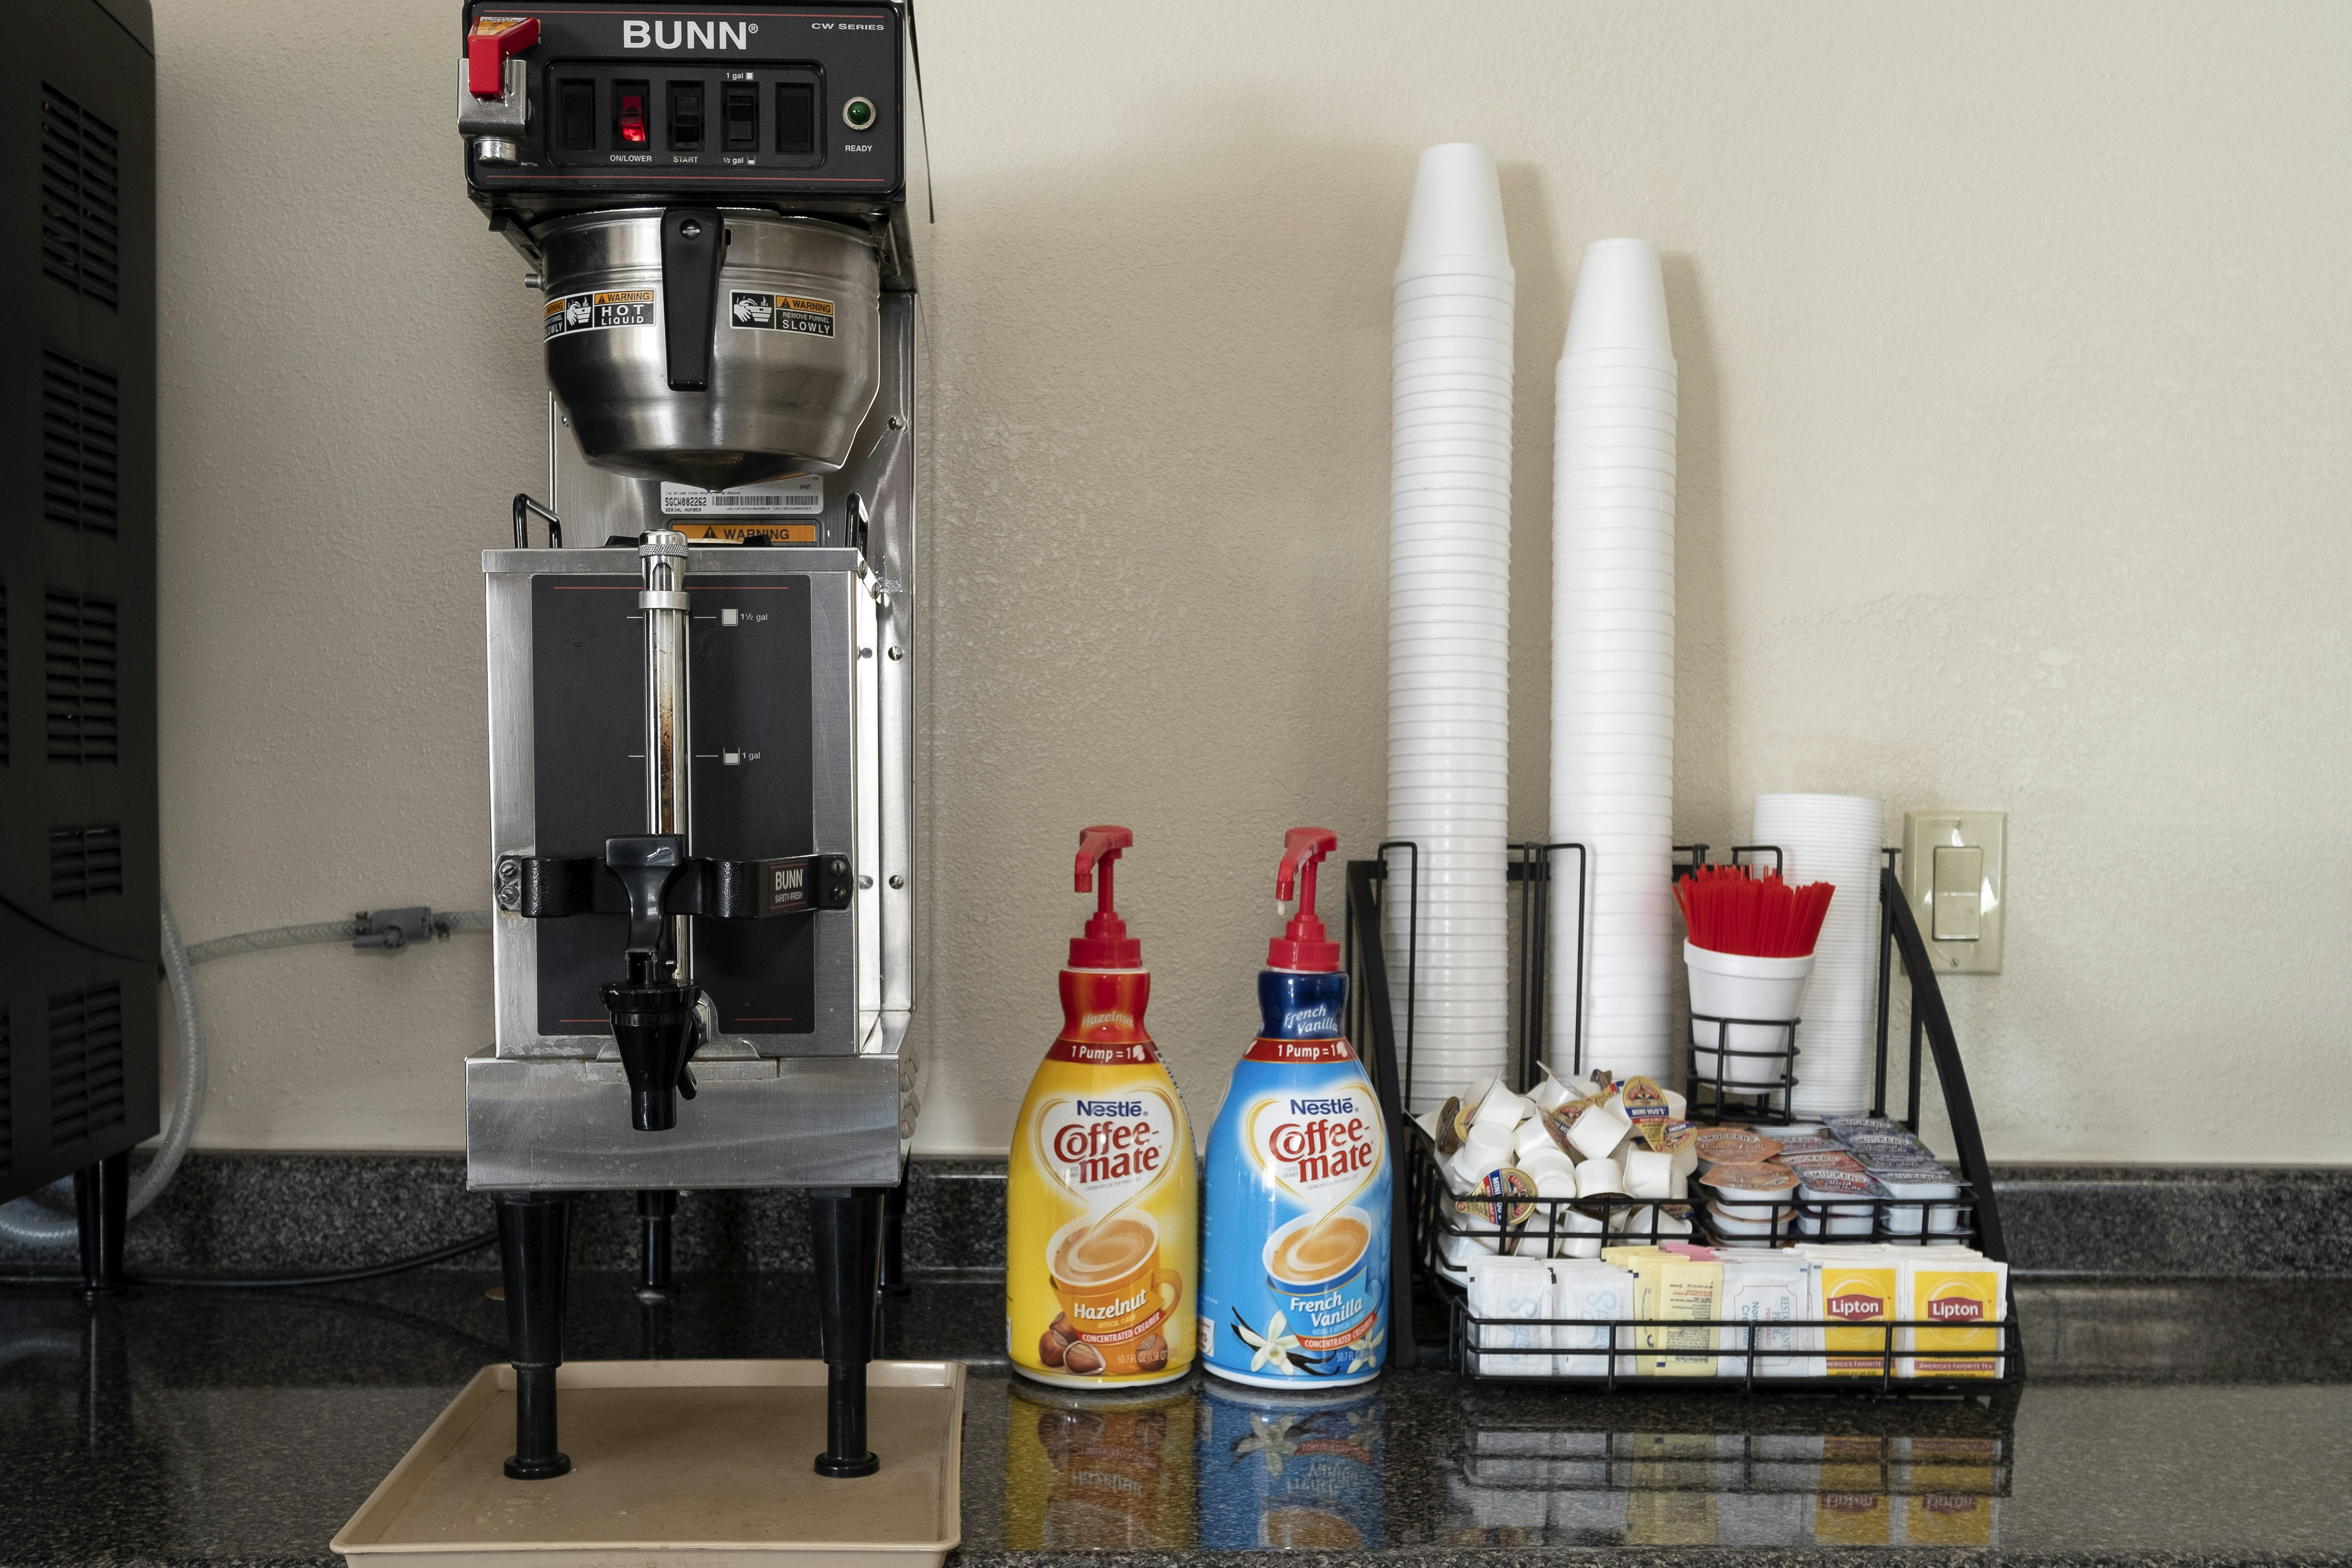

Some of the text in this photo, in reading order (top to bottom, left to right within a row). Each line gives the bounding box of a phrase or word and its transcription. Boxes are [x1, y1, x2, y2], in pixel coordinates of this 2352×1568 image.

[608, 292, 650, 302] WARNING
[602, 305, 644, 317] HOT
[793, 299, 831, 313] WARNING
[602, 316, 644, 325] LIQUID
[782, 319, 830, 334] SLOWLY
[809, 315, 830, 323] FUNNEL
[756, 613, 768, 622] gal
[749, 752, 760, 760] gal
[1284, 1004, 1326, 1029] French
[1298, 1017, 1338, 1035] Vanilla
[1072, 1045, 1076, 1057] 1
[1079, 1045, 1113, 1063] Pump
[1126, 1047, 1131, 1059] 1
[1278, 1045, 1282, 1057] 1
[1287, 1044, 1320, 1060] Pump
[1331, 1044, 1335, 1056] 1
[1079, 1147, 1159, 1183] mate
[1298, 1142, 1372, 1183] mate
[1074, 1289, 1146, 1319] Hazelnut
[1290, 1291, 1343, 1312] French
[1832, 1299, 1878, 1316] Lipton
[1311, 1298, 1363, 1327] Vanilla
[1933, 1302, 1978, 1319] Lipton
[1082, 1312, 1160, 1343] CONCENTRATED CREAMER
[1304, 1333, 1352, 1348] CONCENTRATED
[1352, 1317, 1373, 1339] CREAMER
